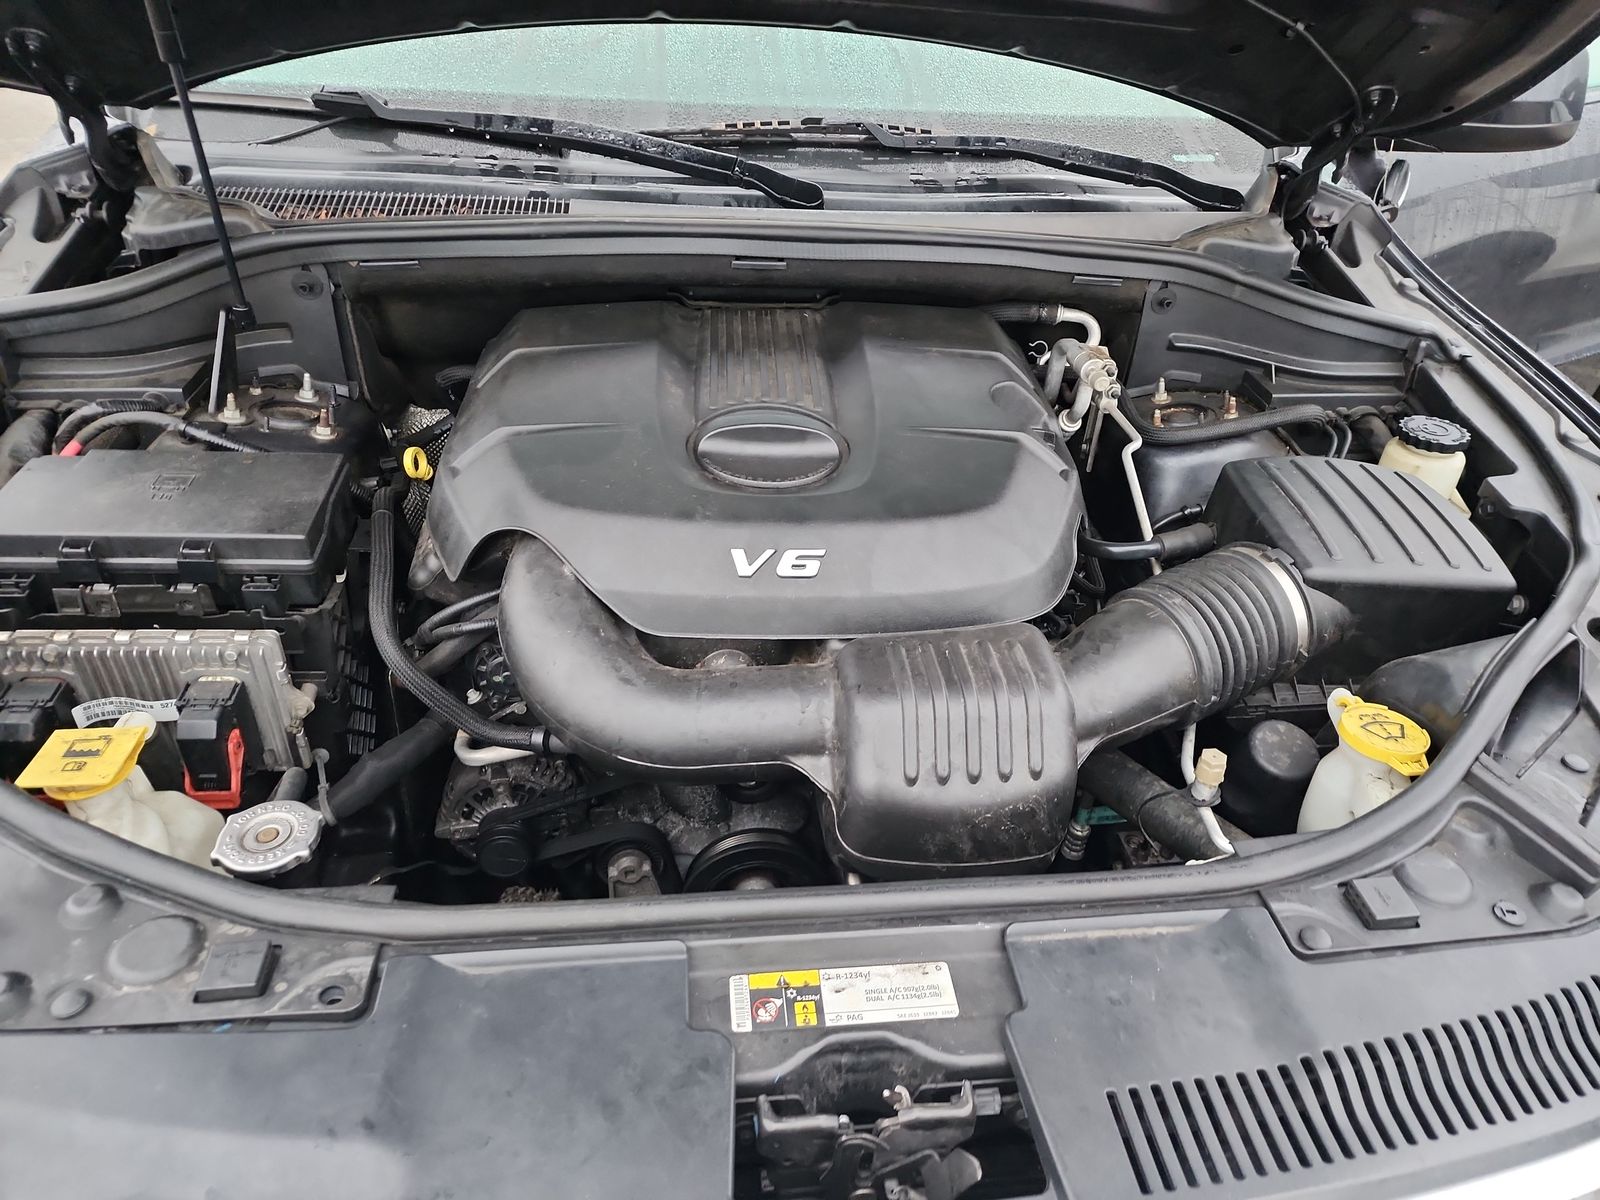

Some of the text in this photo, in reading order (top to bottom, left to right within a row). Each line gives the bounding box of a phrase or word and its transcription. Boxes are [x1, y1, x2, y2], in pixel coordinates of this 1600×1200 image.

[730, 548, 827, 579] V6
[835, 970, 871, 980] R-1234yf
[864, 987, 887, 995] SINGLE
[887, 993, 900, 1001] A/C
[847, 1013, 863, 1021] PAG
